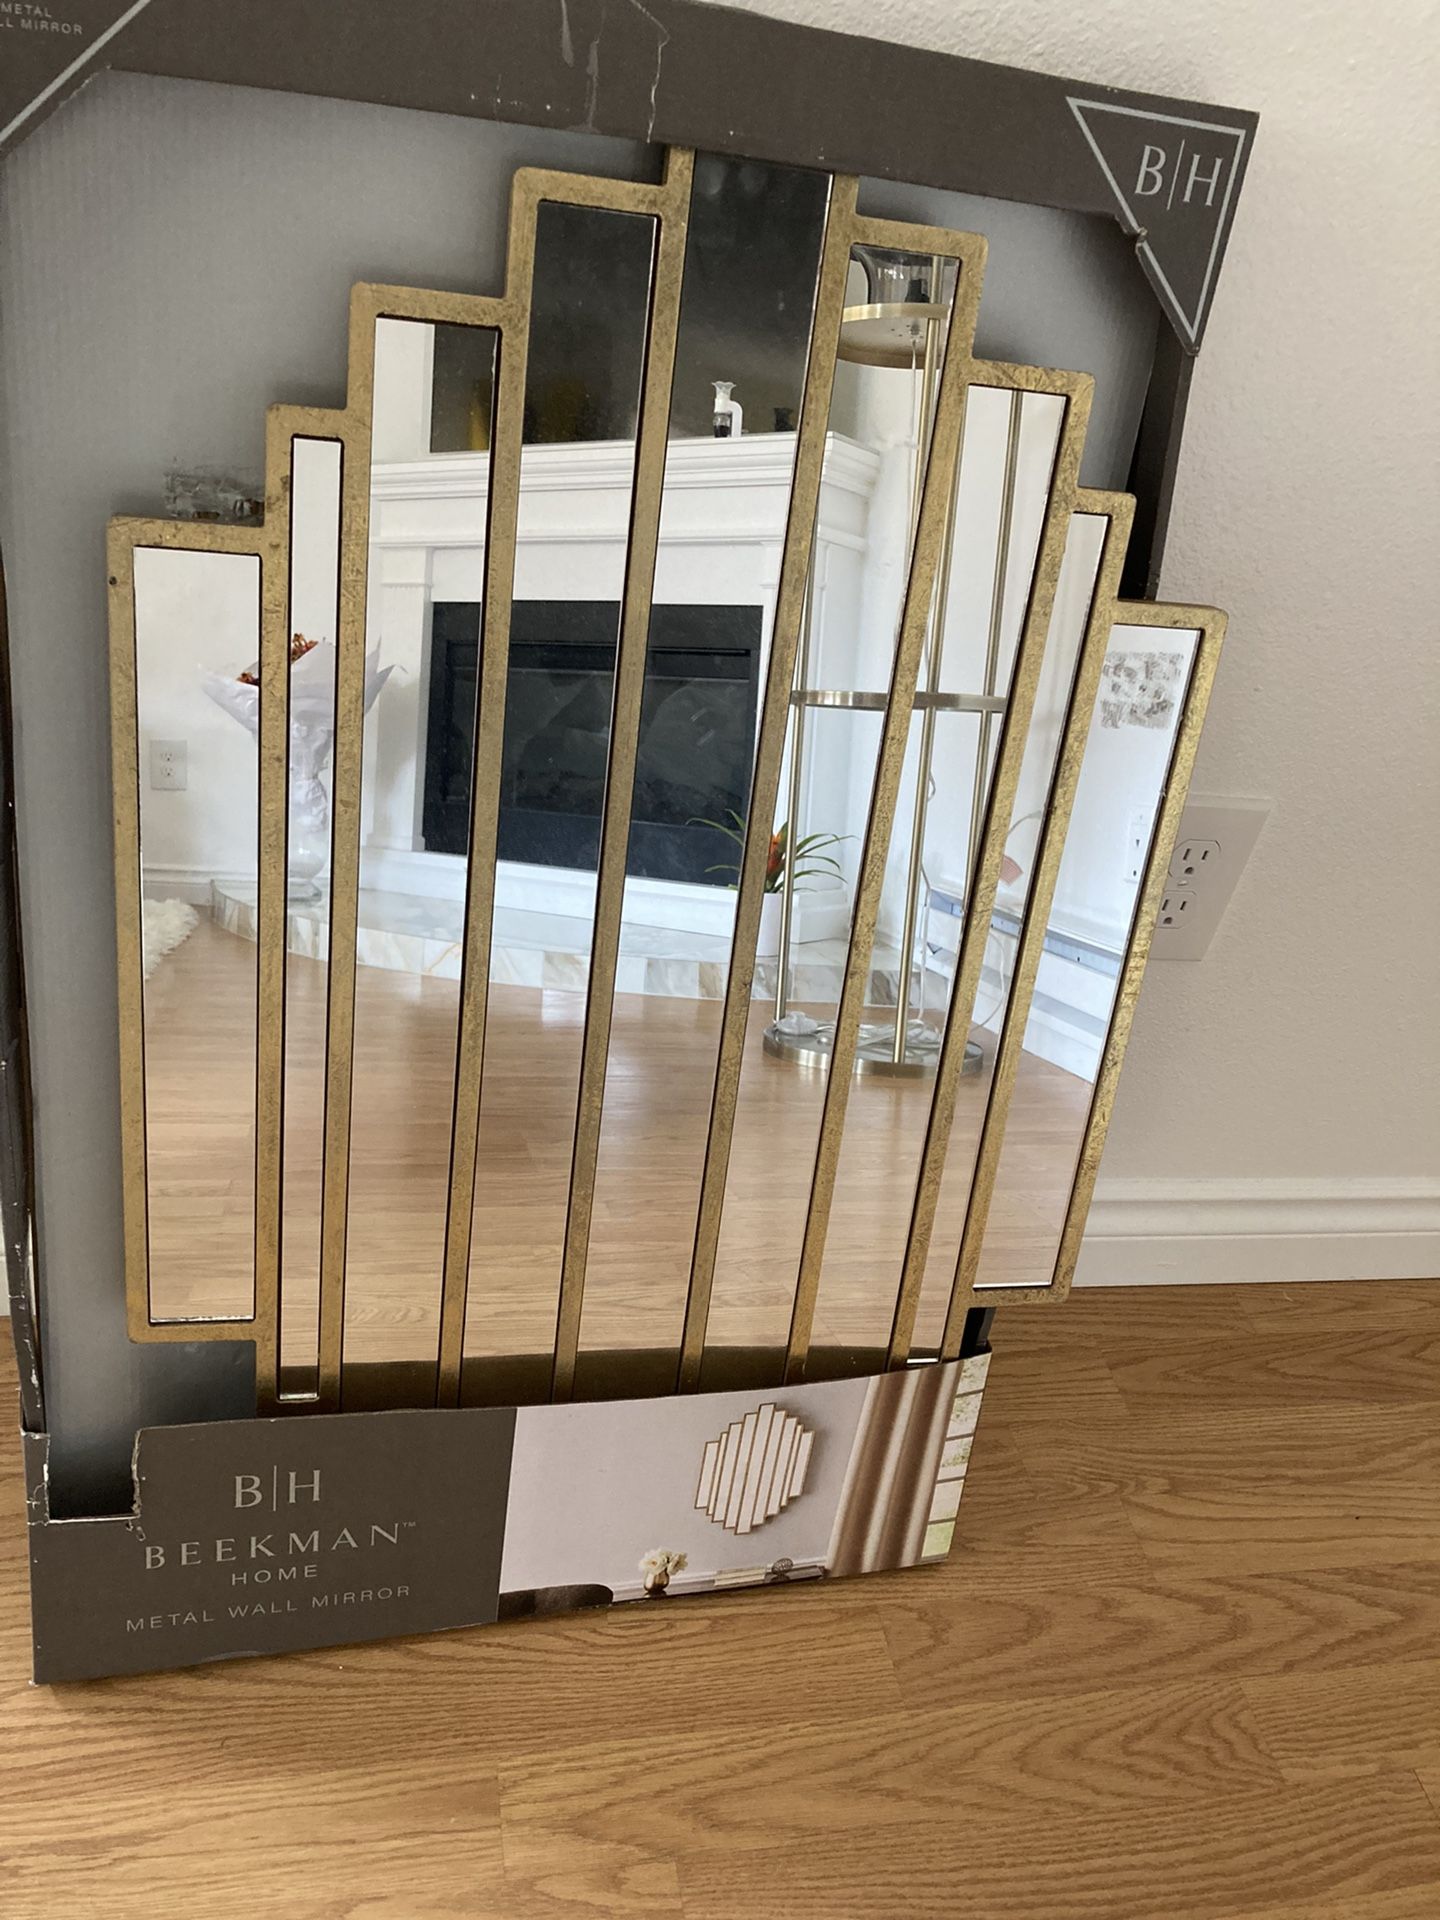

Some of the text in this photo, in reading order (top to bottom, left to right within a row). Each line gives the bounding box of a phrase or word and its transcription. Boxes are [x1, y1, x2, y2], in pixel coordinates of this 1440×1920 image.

[0, 3, 53, 18] METAL
[20, 19, 83, 35] MIRROR
[231, 1564, 318, 1586] HOME
[126, 1585, 410, 1632] METAL WALL MIRROR
